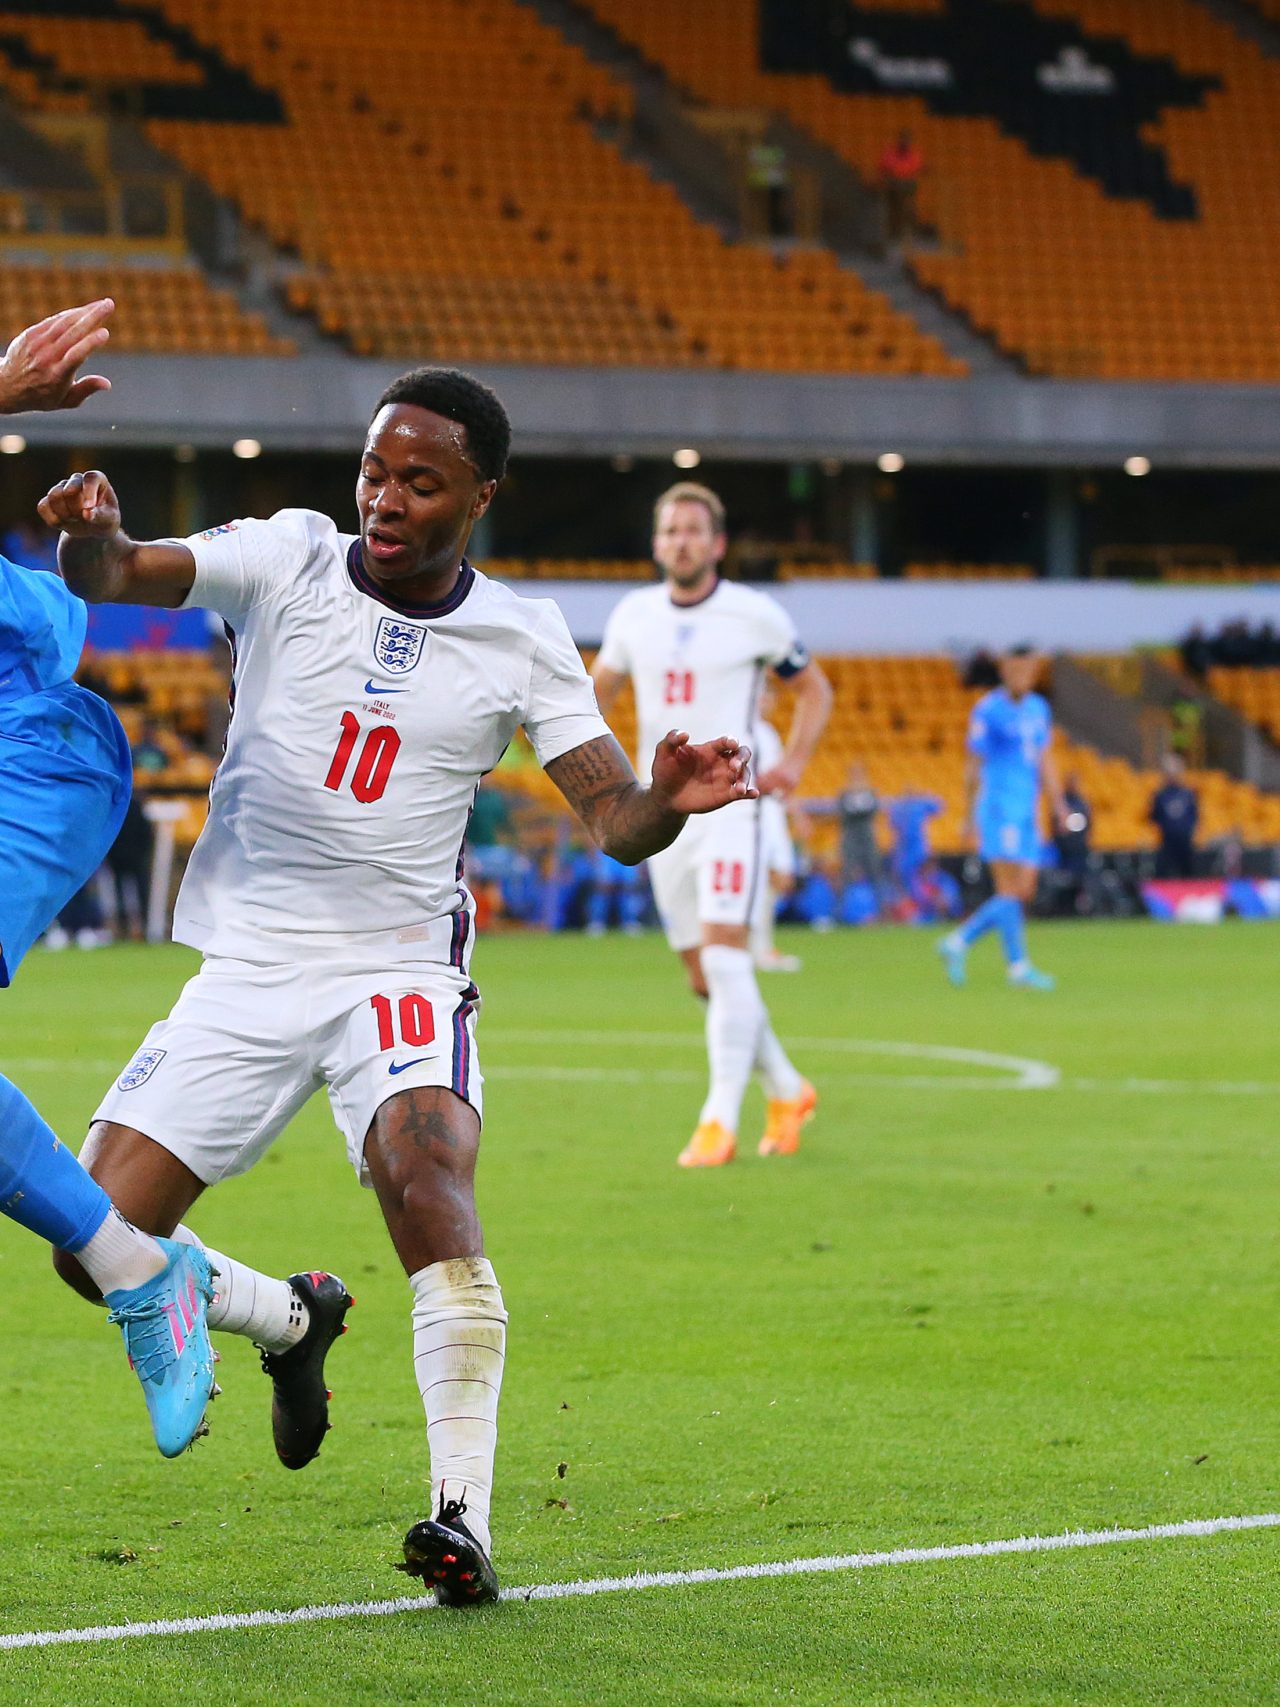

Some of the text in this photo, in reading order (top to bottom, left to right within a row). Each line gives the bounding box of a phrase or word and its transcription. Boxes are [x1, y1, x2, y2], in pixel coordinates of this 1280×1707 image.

[373, 700, 391, 710] ITALY
[663, 669, 696, 705] 20
[368, 706, 383, 716] JUNE
[382, 710, 396, 721] 2022
[323, 710, 402, 804] 10
[370, 993, 436, 1052] 10
